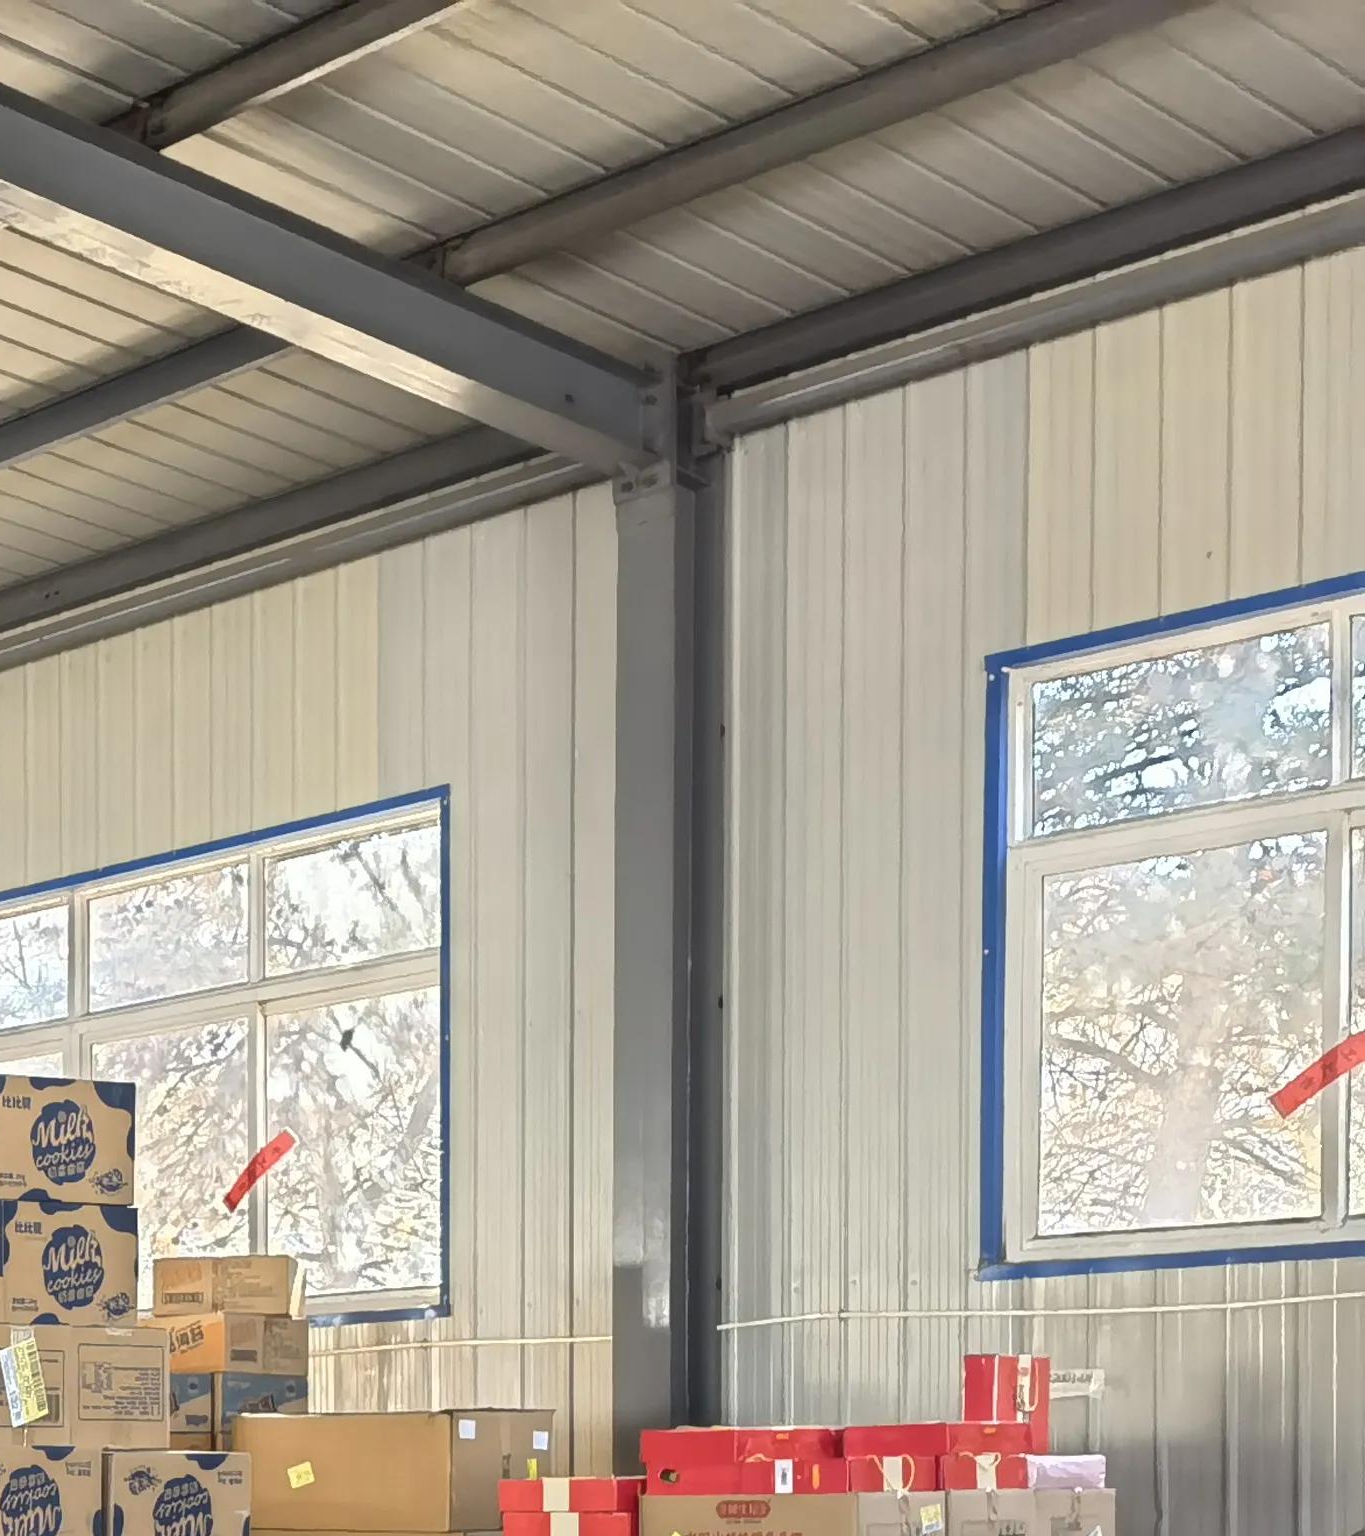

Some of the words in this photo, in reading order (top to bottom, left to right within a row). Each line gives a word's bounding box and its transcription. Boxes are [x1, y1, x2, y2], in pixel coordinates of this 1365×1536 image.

[31, 1106, 94, 1148] Milk
[35, 1144, 95, 1168] cookies
[43, 1230, 102, 1271] Milk
[47, 1267, 105, 1291] cookies
